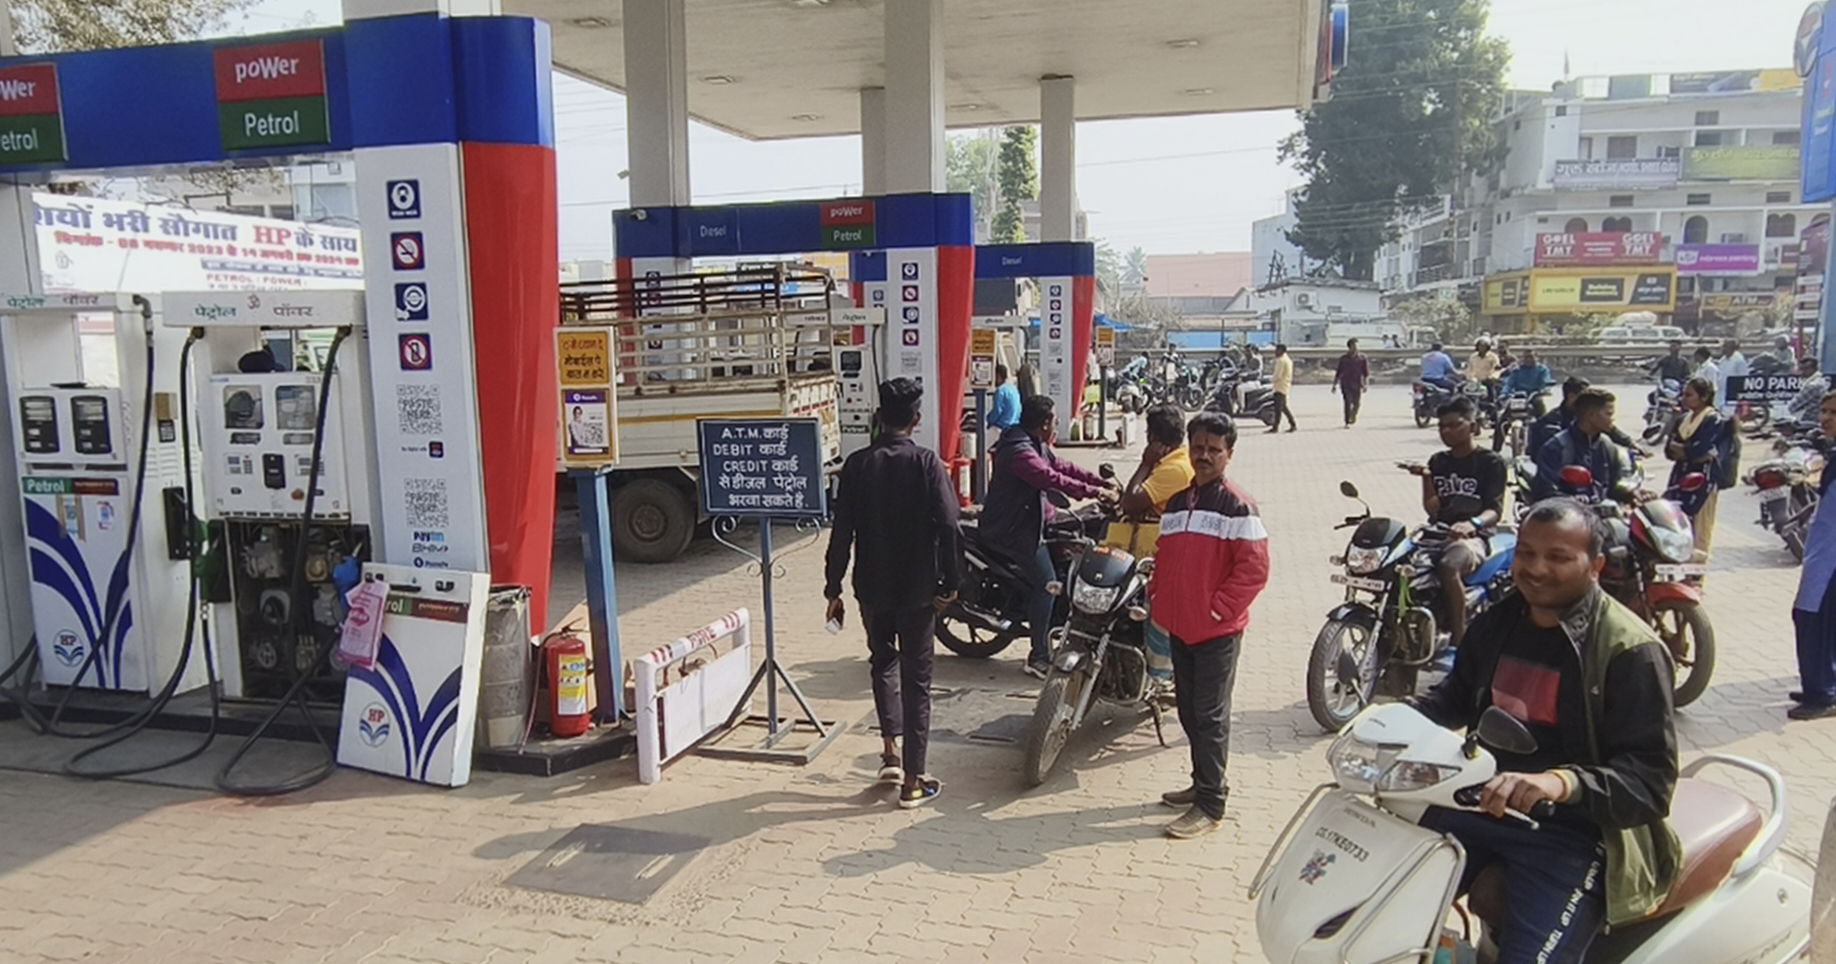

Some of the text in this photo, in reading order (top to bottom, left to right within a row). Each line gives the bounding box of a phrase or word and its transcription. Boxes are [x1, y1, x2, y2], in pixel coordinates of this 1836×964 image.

[0, 79, 36, 101] Wer
[245, 110, 299, 137] Petrol
[158, 212, 237, 241] सौगात
[254, 225, 291, 246] HP
[701, 225, 726, 238] Diesel
[833, 230, 862, 242] Petrol
[1542, 234, 1576, 245] GOEL
[1622, 233, 1655, 244] GOEL
[1545, 246, 1573, 255] TMT
[1625, 245, 1652, 255] TMT
[1732, 296, 1758, 305] ATM
[195, 303, 237, 321] पेट्रोल
[1743, 376, 1764, 390] NO
[721, 427, 762, 439] A.T.M.
[713, 444, 753, 456] DEBIT
[723, 460, 768, 473] CREDIT
[26, 478, 65, 493] Petrol
[772, 472, 807, 492] पेट्रोल
[368, 709, 385, 723] HP
